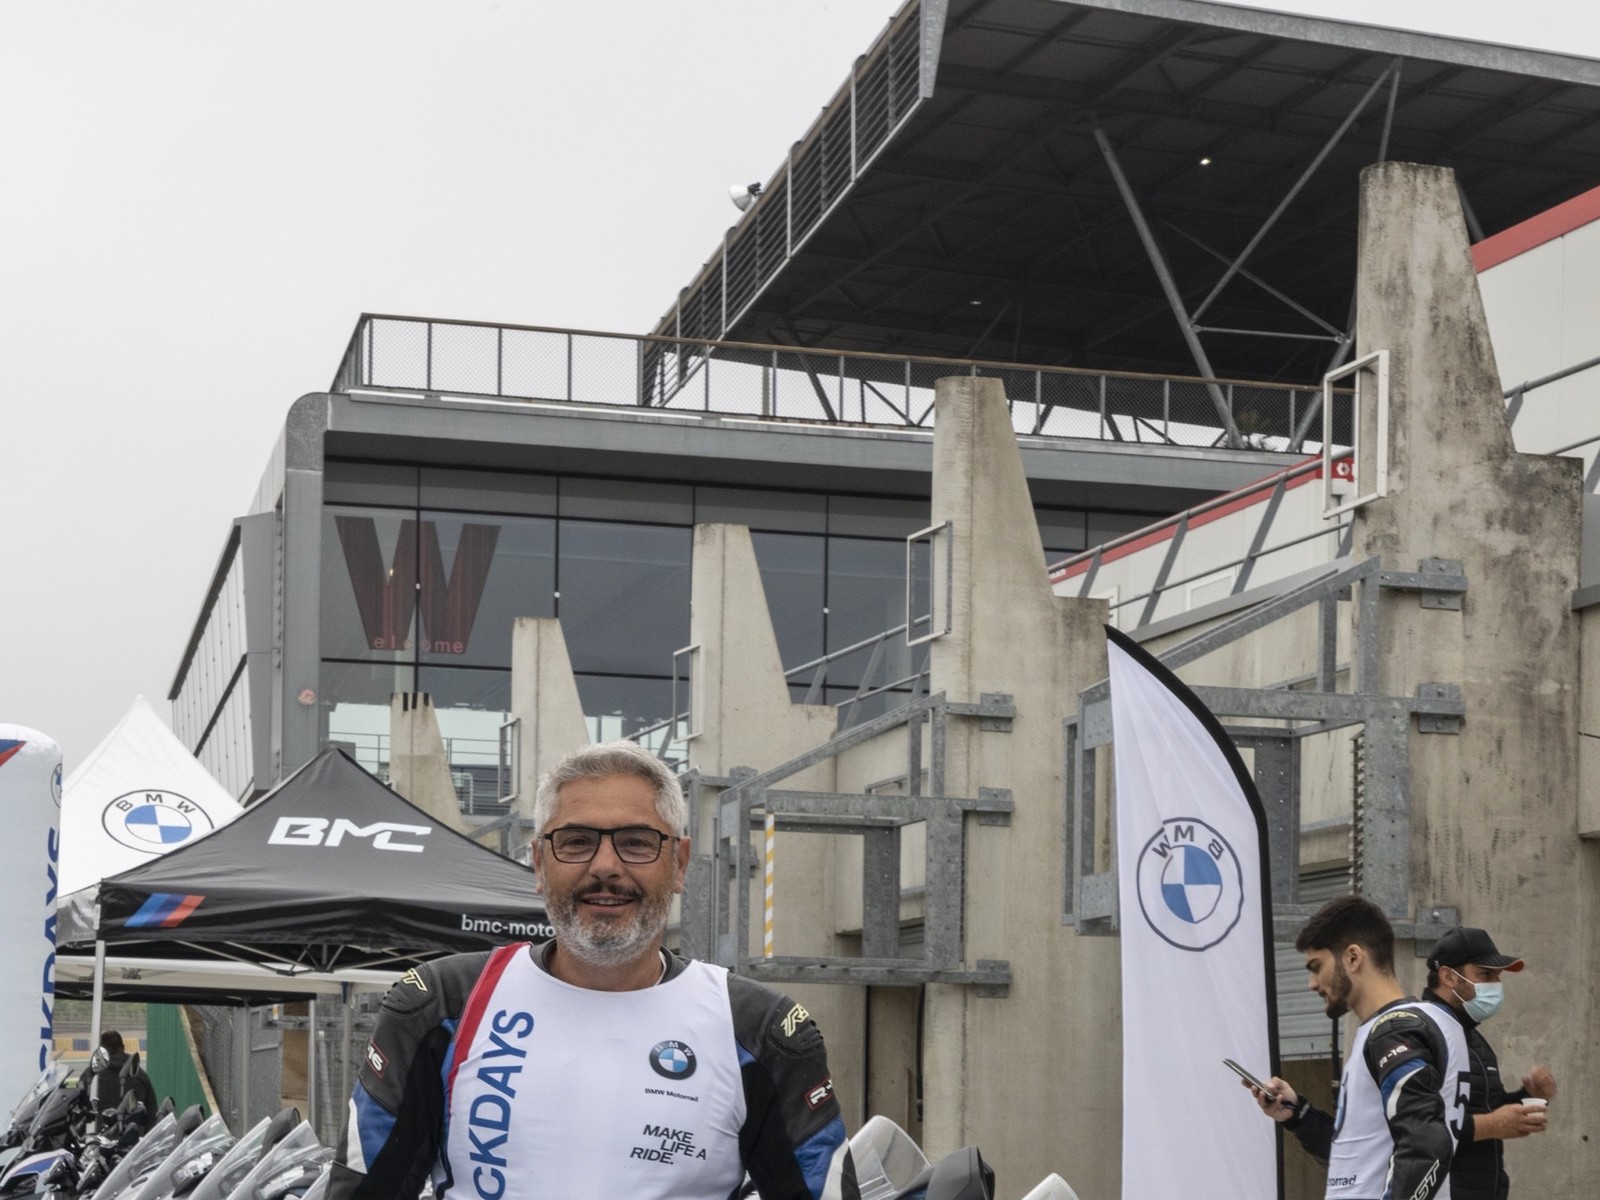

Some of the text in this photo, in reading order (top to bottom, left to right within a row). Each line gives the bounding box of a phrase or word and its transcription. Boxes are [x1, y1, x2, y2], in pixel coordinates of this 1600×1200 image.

[115, 793, 196, 815] BMW
[267, 816, 432, 853] BMC
[644, 1088, 699, 1102] BMW Motorrad
[642, 1124, 694, 1144] MAKE
[630, 1147, 675, 1165] RIDE.
[660, 1140, 707, 1161] LIFE A
